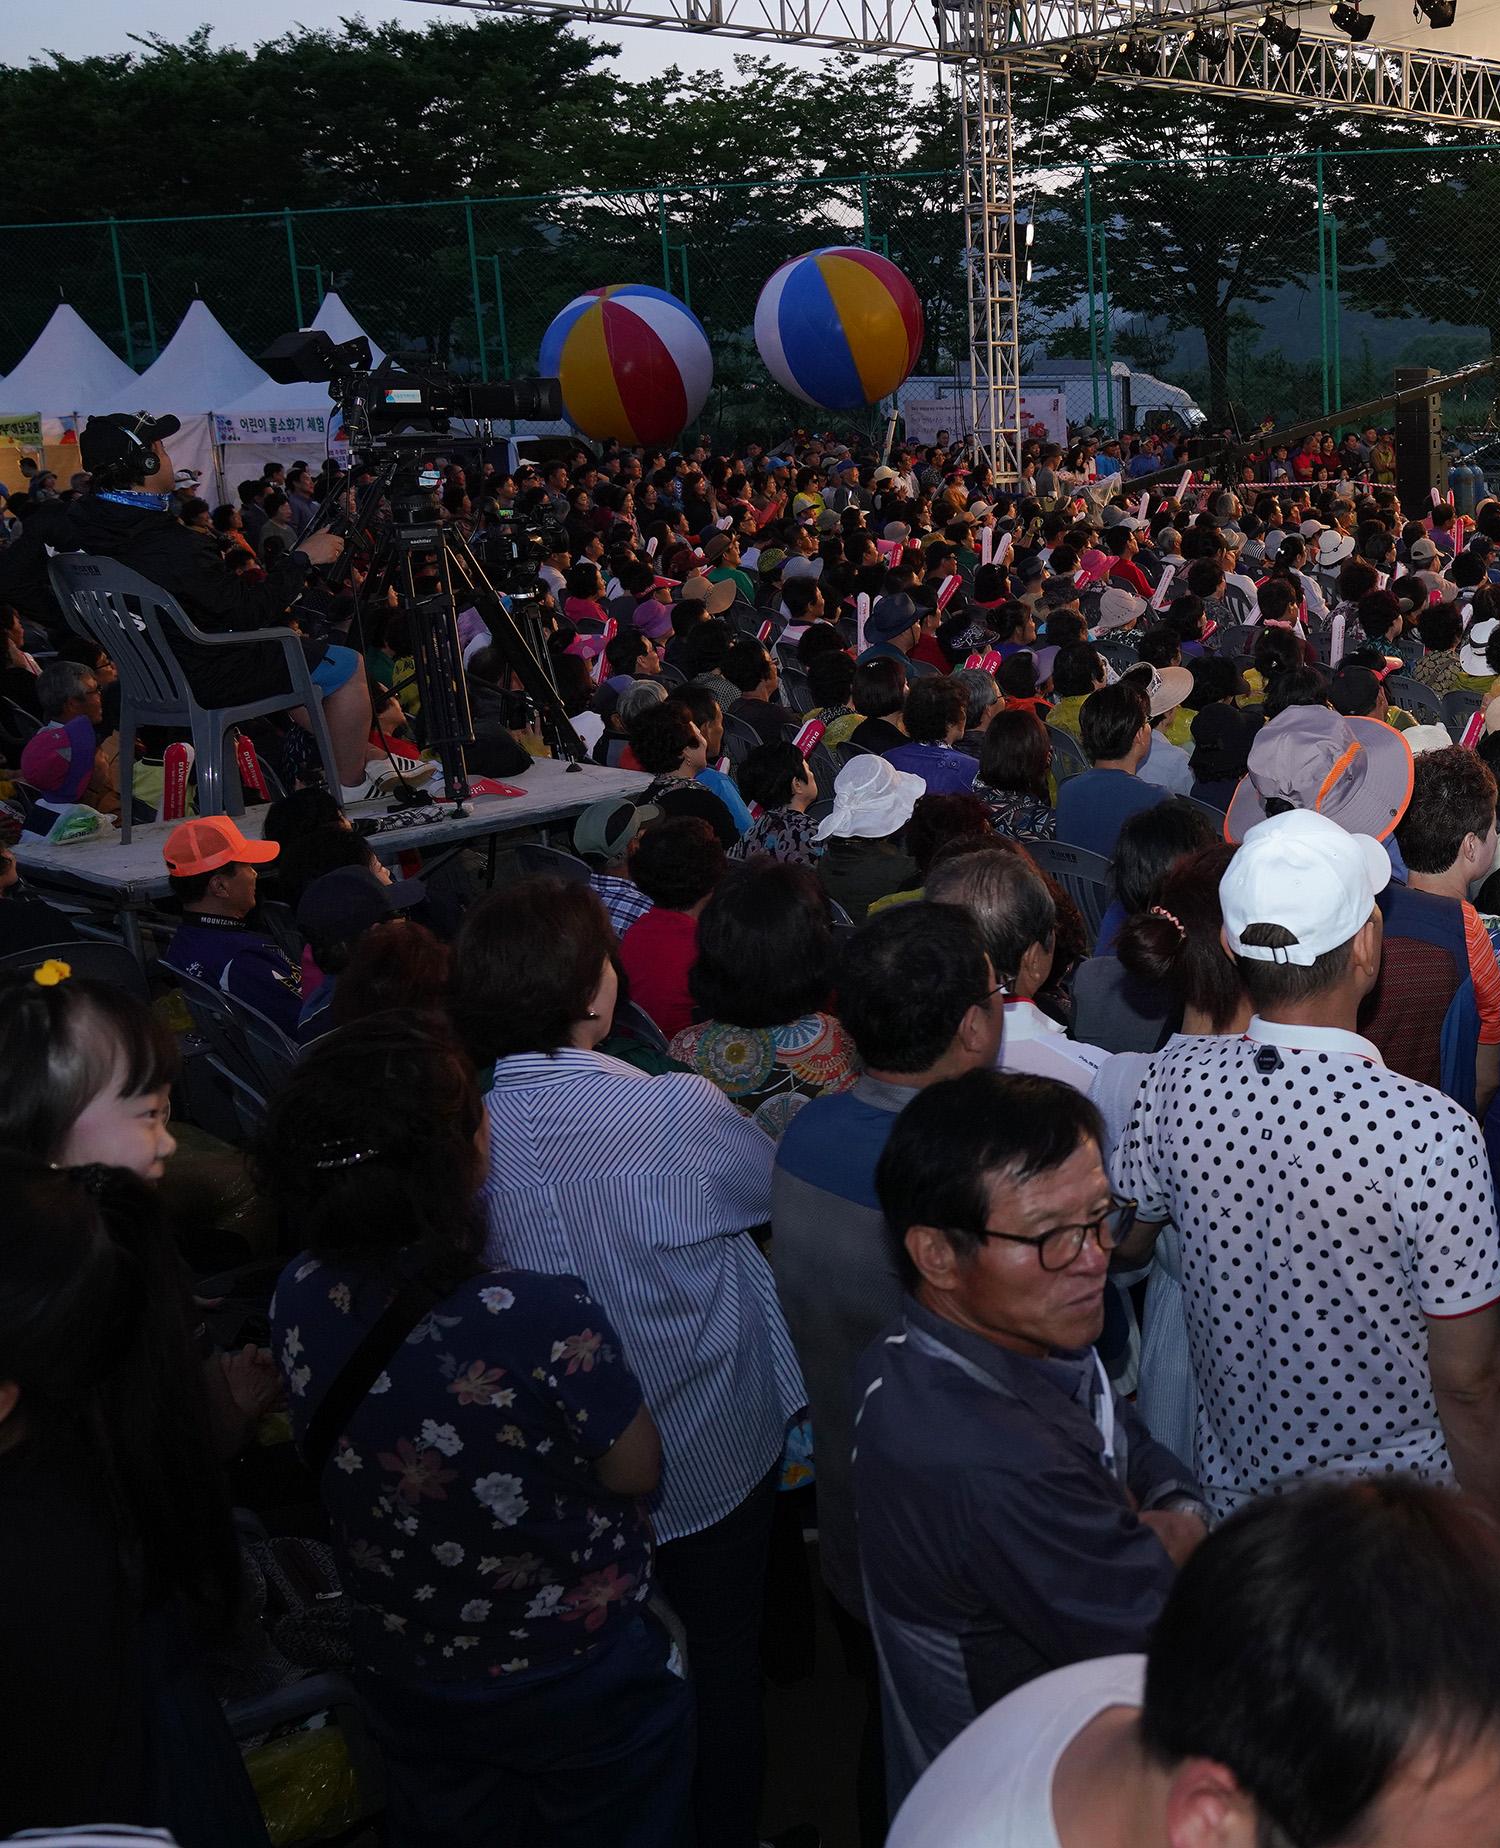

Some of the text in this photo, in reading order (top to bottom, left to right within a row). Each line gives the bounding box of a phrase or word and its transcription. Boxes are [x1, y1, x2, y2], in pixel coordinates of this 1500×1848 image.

[240, 415, 326, 434] 어린이 물소화기 체험
[805, 731, 820, 749] D'LIVE
